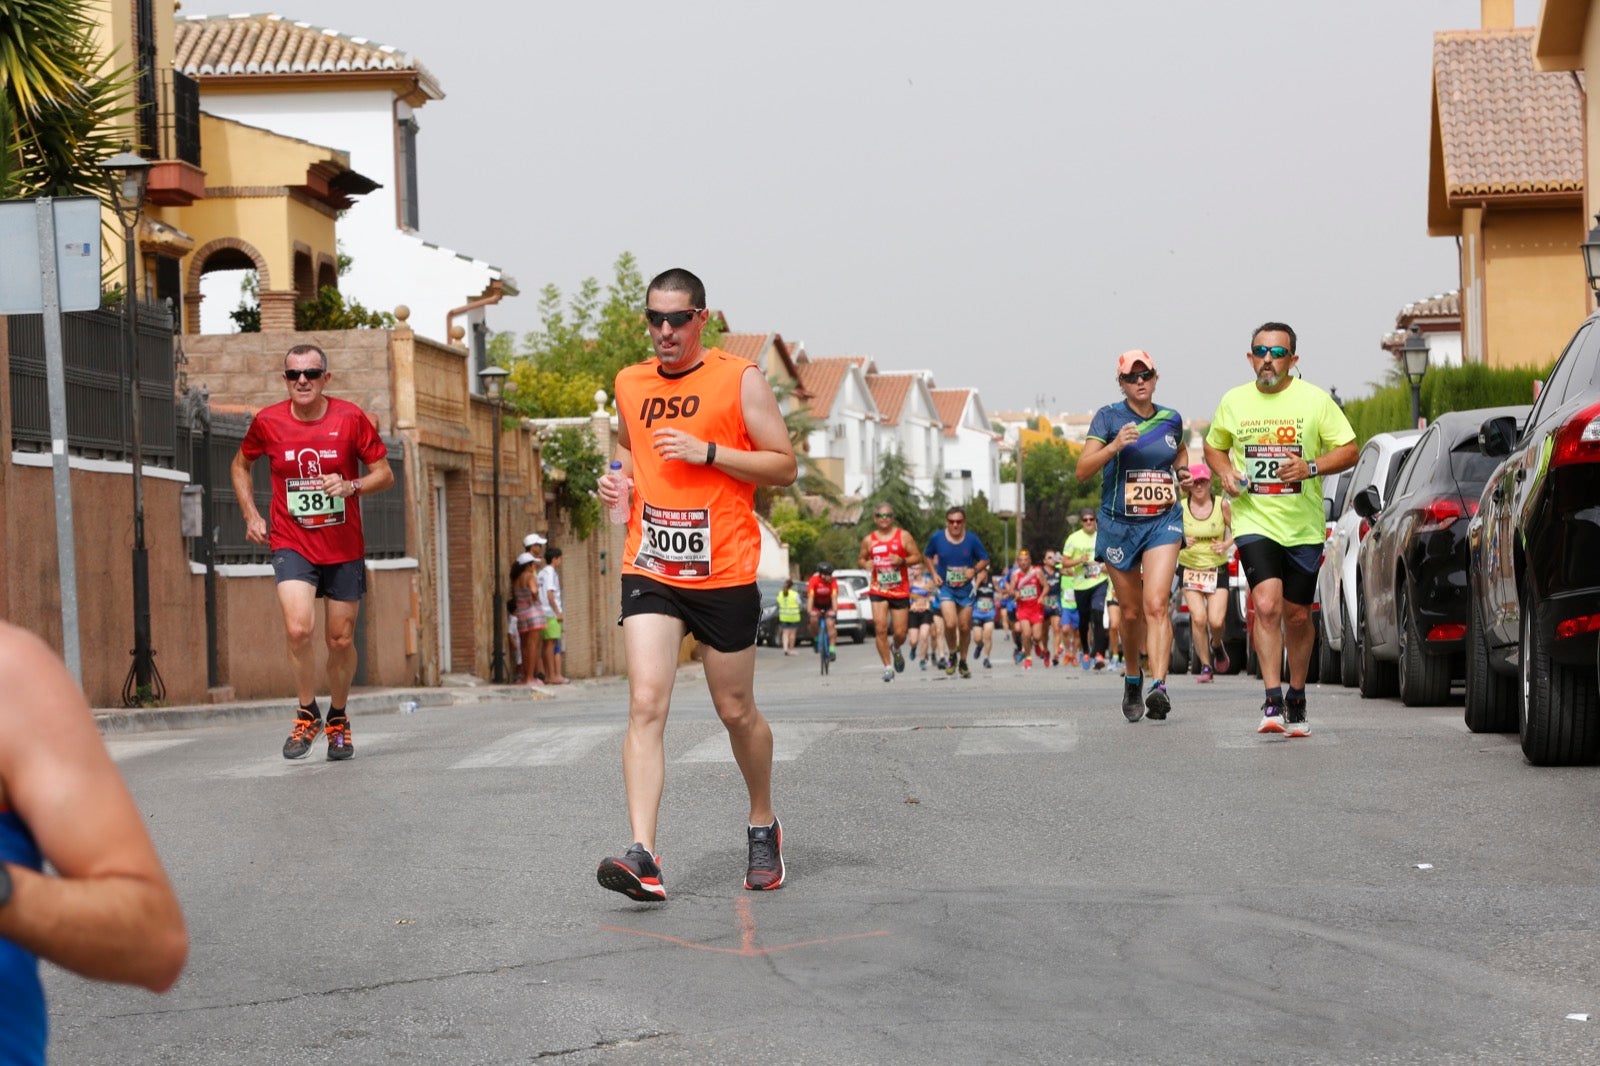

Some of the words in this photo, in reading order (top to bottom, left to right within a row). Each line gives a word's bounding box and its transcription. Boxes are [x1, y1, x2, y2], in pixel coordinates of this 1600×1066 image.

[1263, 418, 1295, 426] PREMIO
[1245, 426, 1270, 434] FONDO
[1133, 486, 1173, 501] 2063
[298, 493, 335, 512] 381
[662, 510, 680, 520] PREMIO
[681, 511, 688, 520] DE
[688, 511, 705, 521] FONDO
[647, 526, 704, 553] 3006
